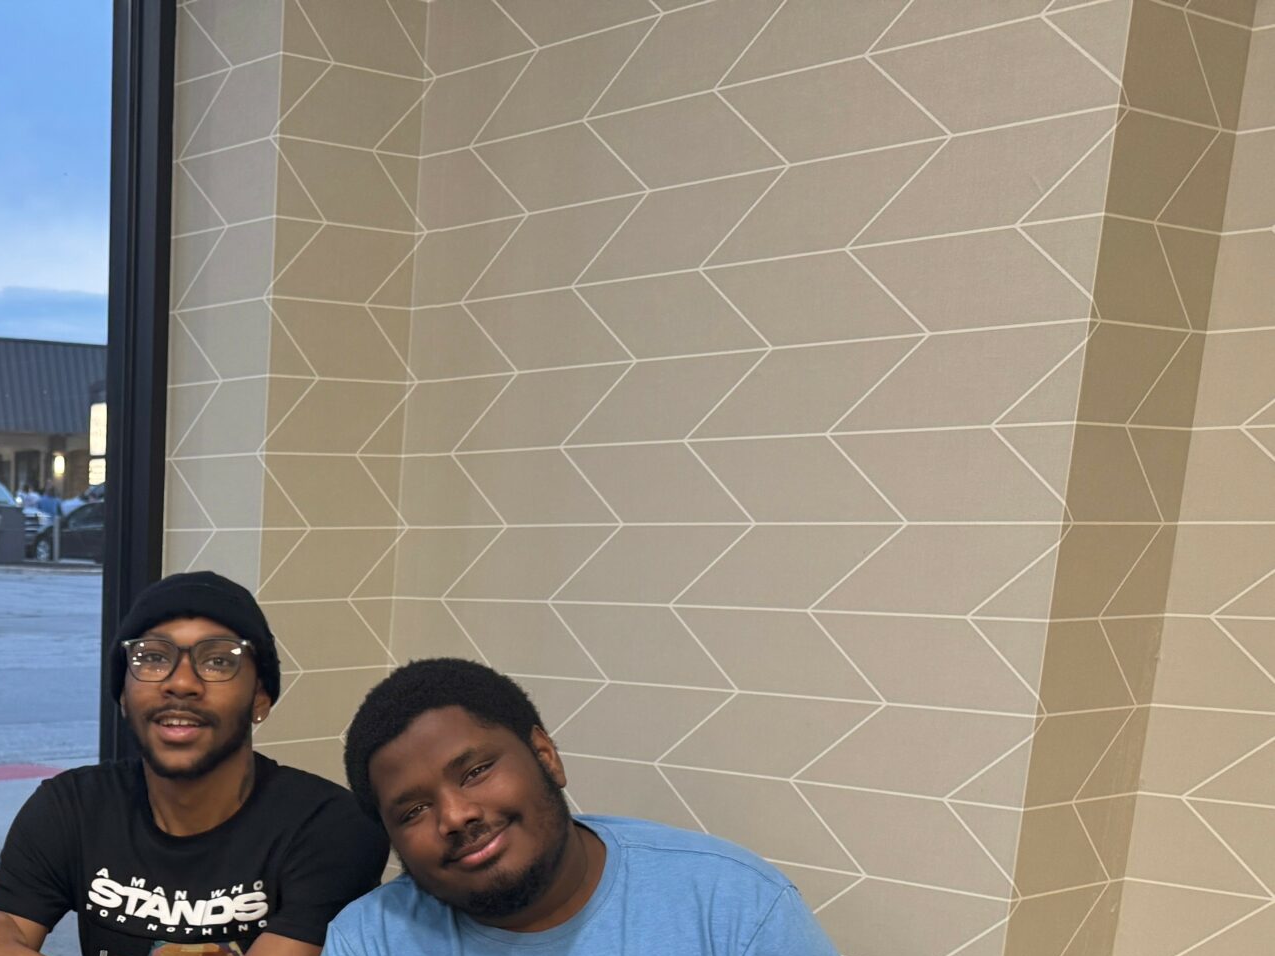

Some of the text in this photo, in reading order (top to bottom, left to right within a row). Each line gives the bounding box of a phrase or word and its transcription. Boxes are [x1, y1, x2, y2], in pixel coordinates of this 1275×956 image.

[95, 867, 264, 899] A MAN WHO
[87, 877, 269, 926] STANDS
[85, 903, 268, 936] FOR NOTHING
